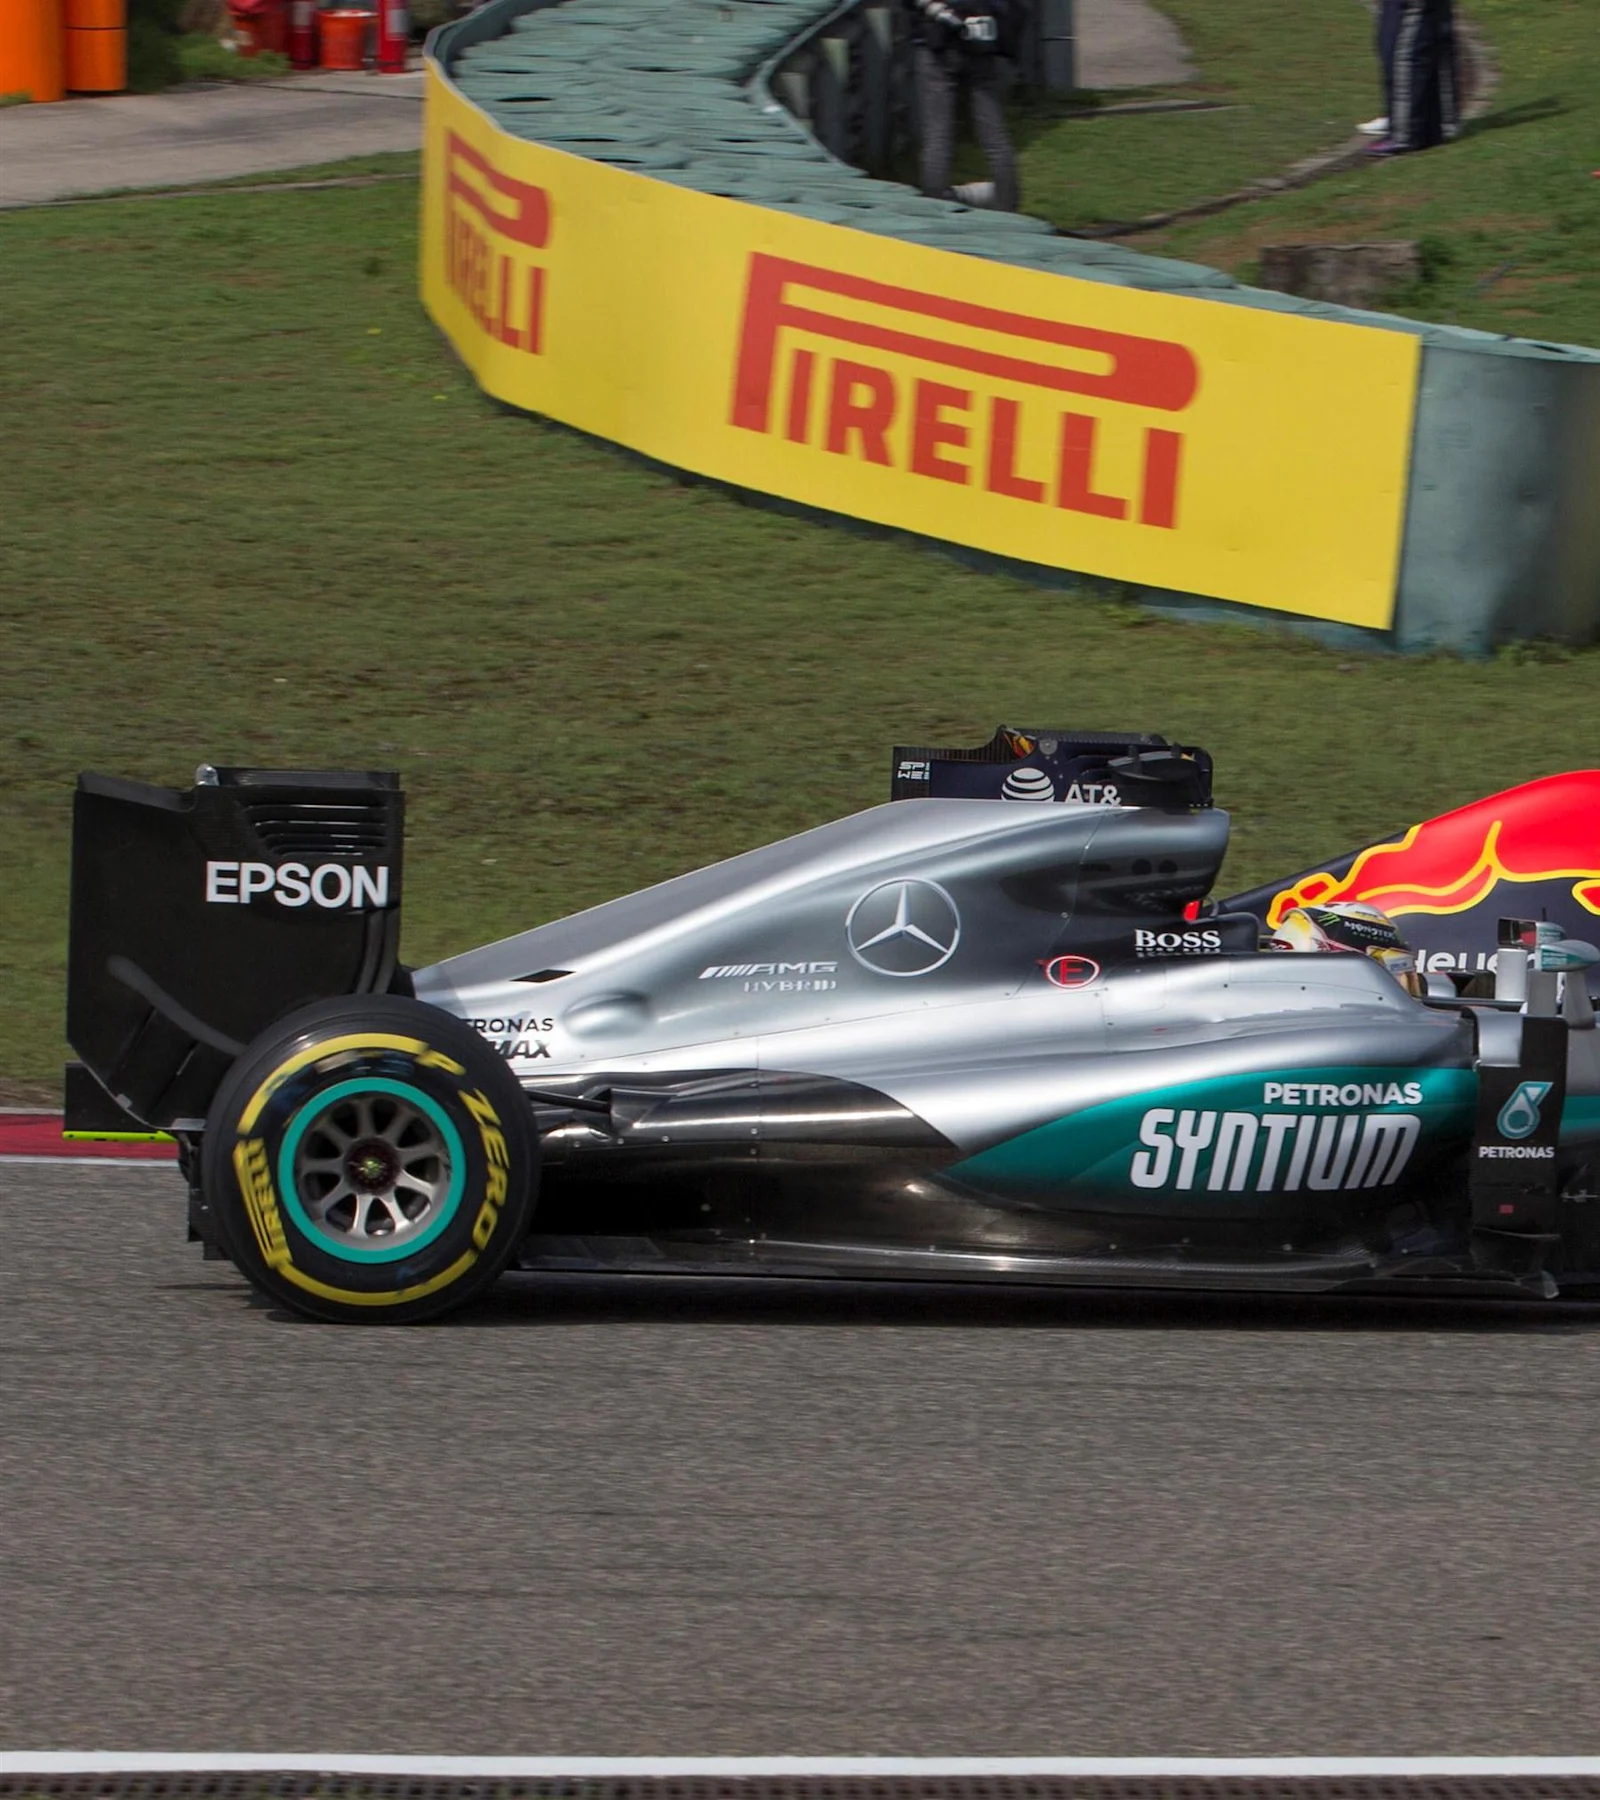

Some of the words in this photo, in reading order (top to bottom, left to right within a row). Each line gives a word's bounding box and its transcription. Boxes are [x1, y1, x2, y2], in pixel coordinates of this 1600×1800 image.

[444, 126, 551, 357] PIRELLI
[728, 251, 1201, 529] PIRELLI
[1064, 783, 1122, 807] AT&
[205, 861, 389, 909] EPSON
[1134, 928, 1222, 948] BOSS
[745, 961, 838, 977] AMG
[743, 979, 837, 993] HYBRID
[1263, 1082, 1423, 1106] PETRONAS
[1129, 1108, 1422, 1192] SYNTIUM
[1479, 1146, 1554, 1159] PETRONAS
[457, 1088, 511, 1251] ZERO
